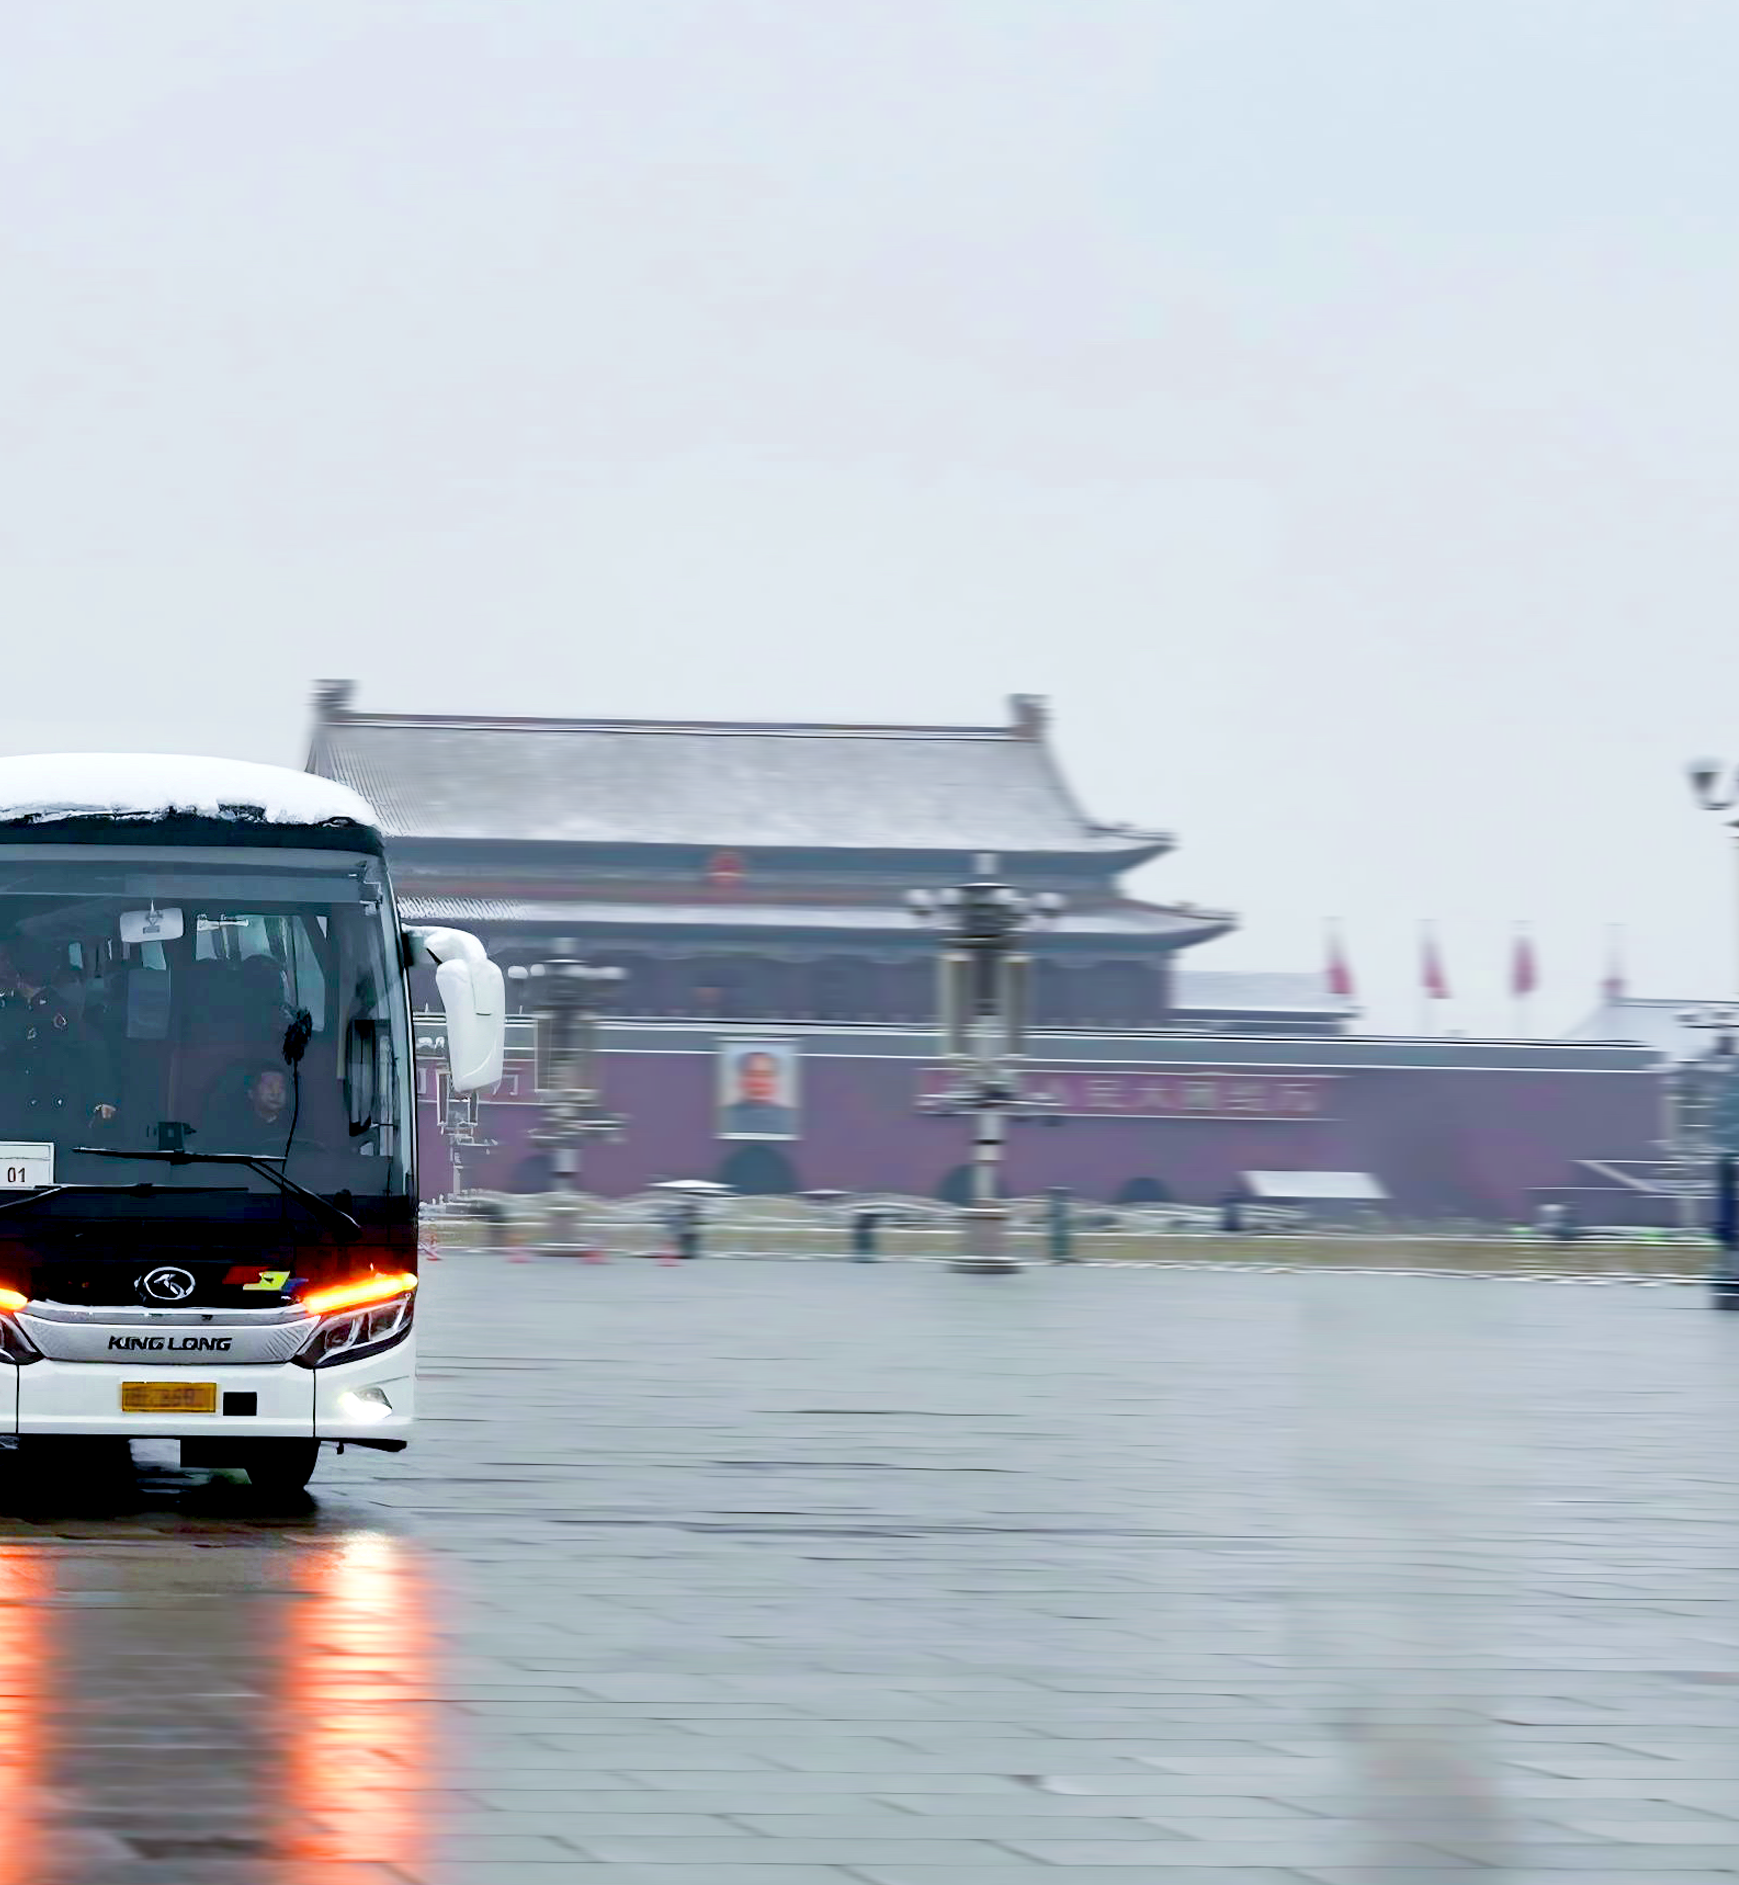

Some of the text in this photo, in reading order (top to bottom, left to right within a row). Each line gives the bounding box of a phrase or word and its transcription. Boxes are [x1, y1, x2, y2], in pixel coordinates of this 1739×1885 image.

[7, 1166, 26, 1183] 01
[107, 1335, 233, 1351] KING LONG
